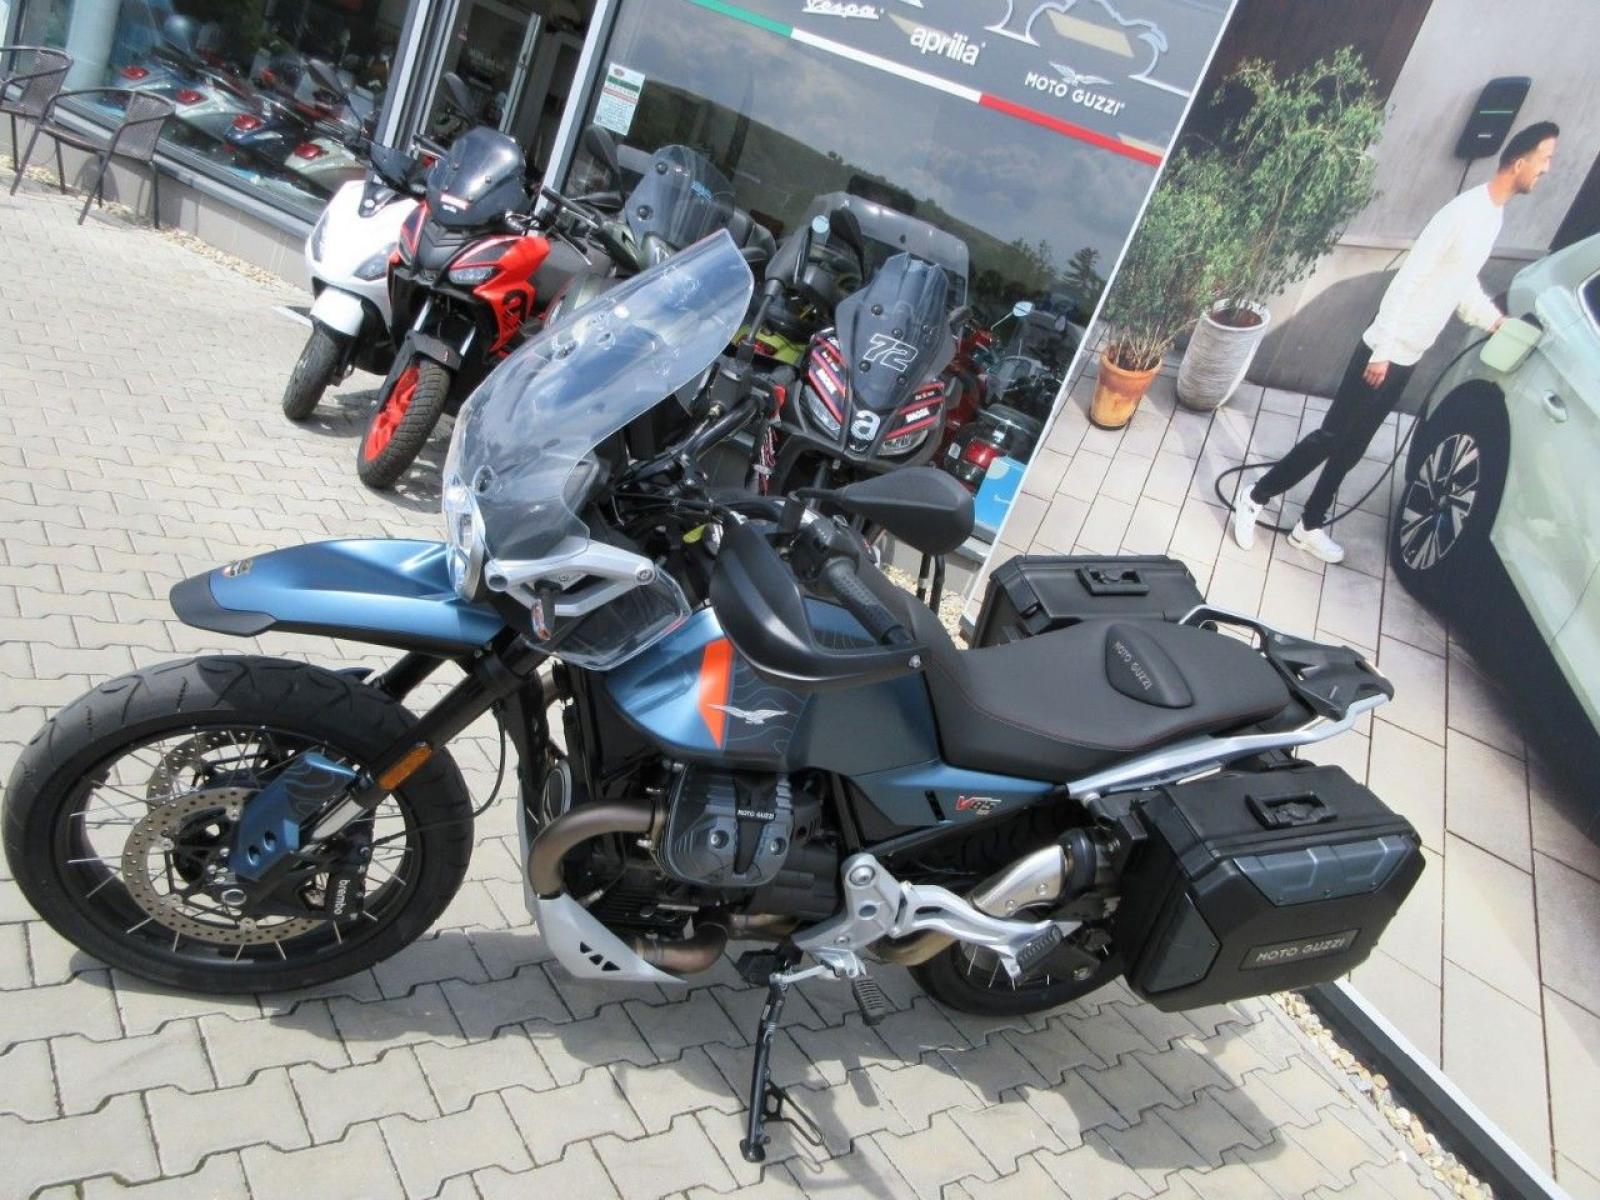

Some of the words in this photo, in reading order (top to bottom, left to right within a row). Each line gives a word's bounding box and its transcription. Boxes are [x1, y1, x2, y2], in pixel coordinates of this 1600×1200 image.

[910, 27, 980, 66] aprilia
[1024, 71, 1068, 97] MOTO
[1072, 89, 1121, 116] GUZZI
[863, 333, 918, 372] 72
[851, 409, 881, 441] a
[1131, 662, 1152, 690] GUZZI
[737, 809, 756, 817] MOTO
[334, 879, 350, 915] brembo
[1255, 947, 1298, 962] MOTO
[1302, 937, 1346, 954] GUZZI
